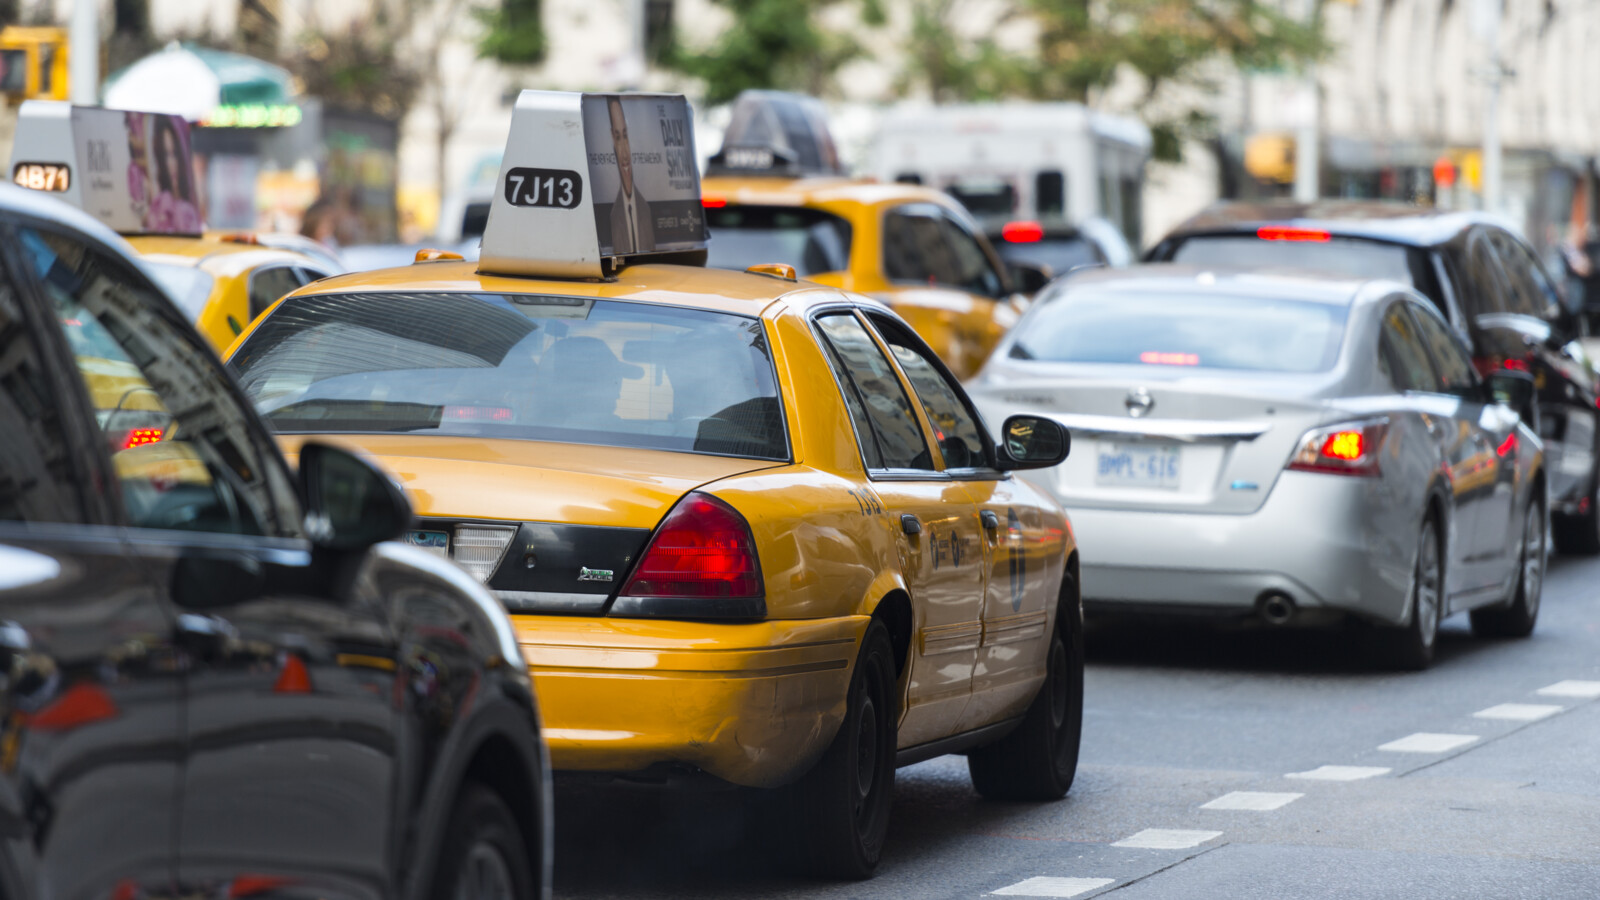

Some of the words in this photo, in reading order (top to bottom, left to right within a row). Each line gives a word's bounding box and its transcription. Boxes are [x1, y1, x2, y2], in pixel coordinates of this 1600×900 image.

[660, 119, 684, 147] DAILY
[666, 149, 693, 178] SHOW
[15, 164, 69, 192] 4B71
[509, 175, 574, 207] 7J13
[848, 488, 881, 516] 7J13
